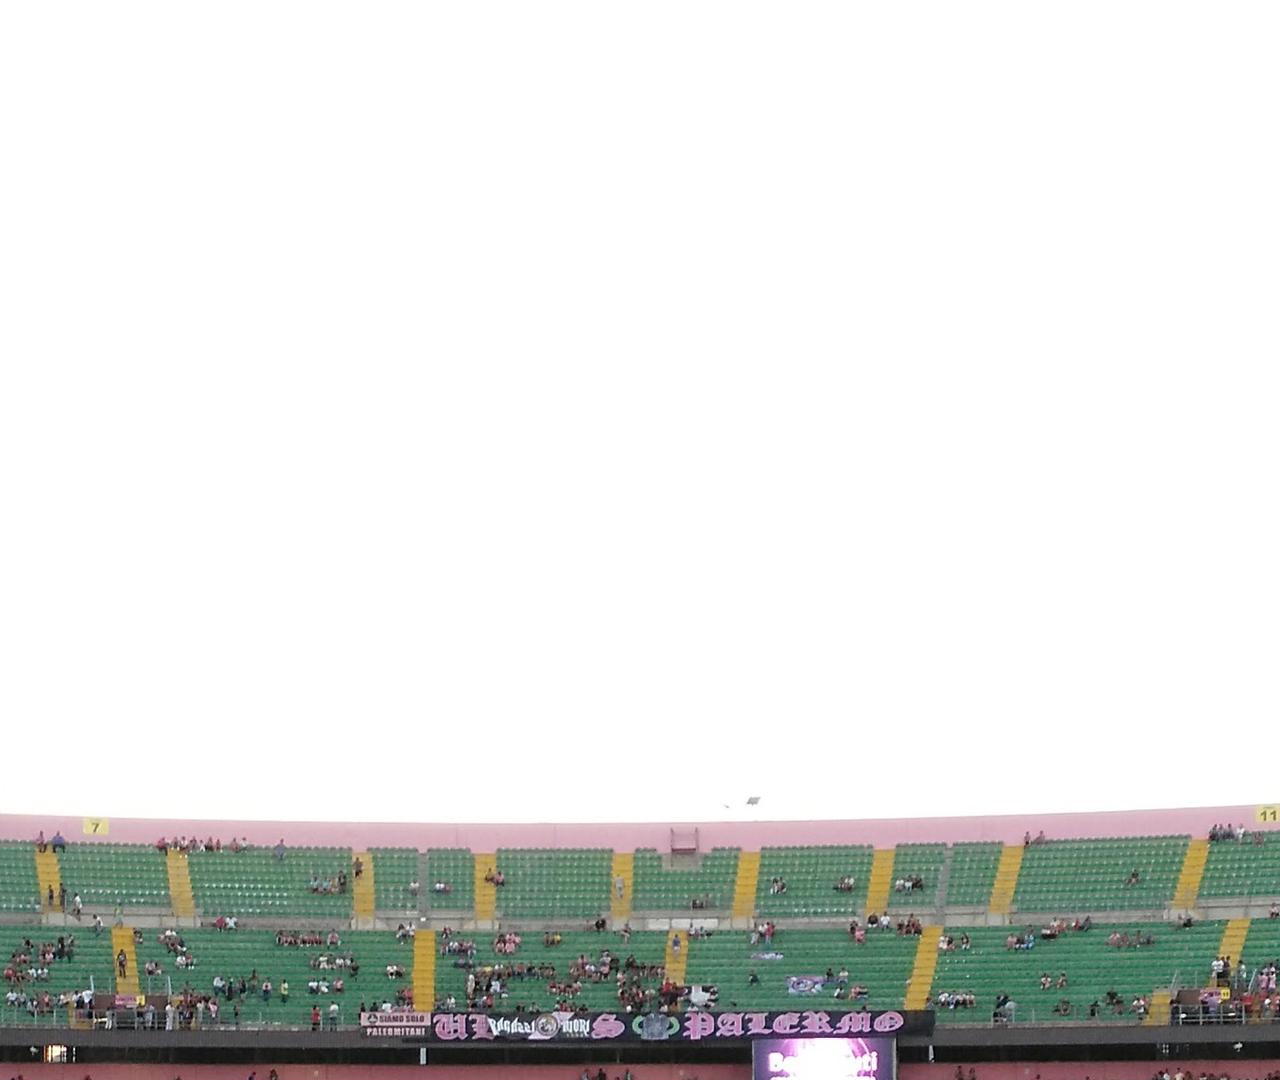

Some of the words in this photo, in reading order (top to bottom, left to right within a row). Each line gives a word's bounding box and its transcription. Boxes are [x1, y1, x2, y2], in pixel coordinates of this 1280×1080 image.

[1261, 810, 1277, 821] 11
[91, 823, 100, 833] 7
[379, 1014, 403, 1024] SIAMO
[405, 1013, 426, 1023] SOLO
[682, 1011, 905, 1040] PALERMO
